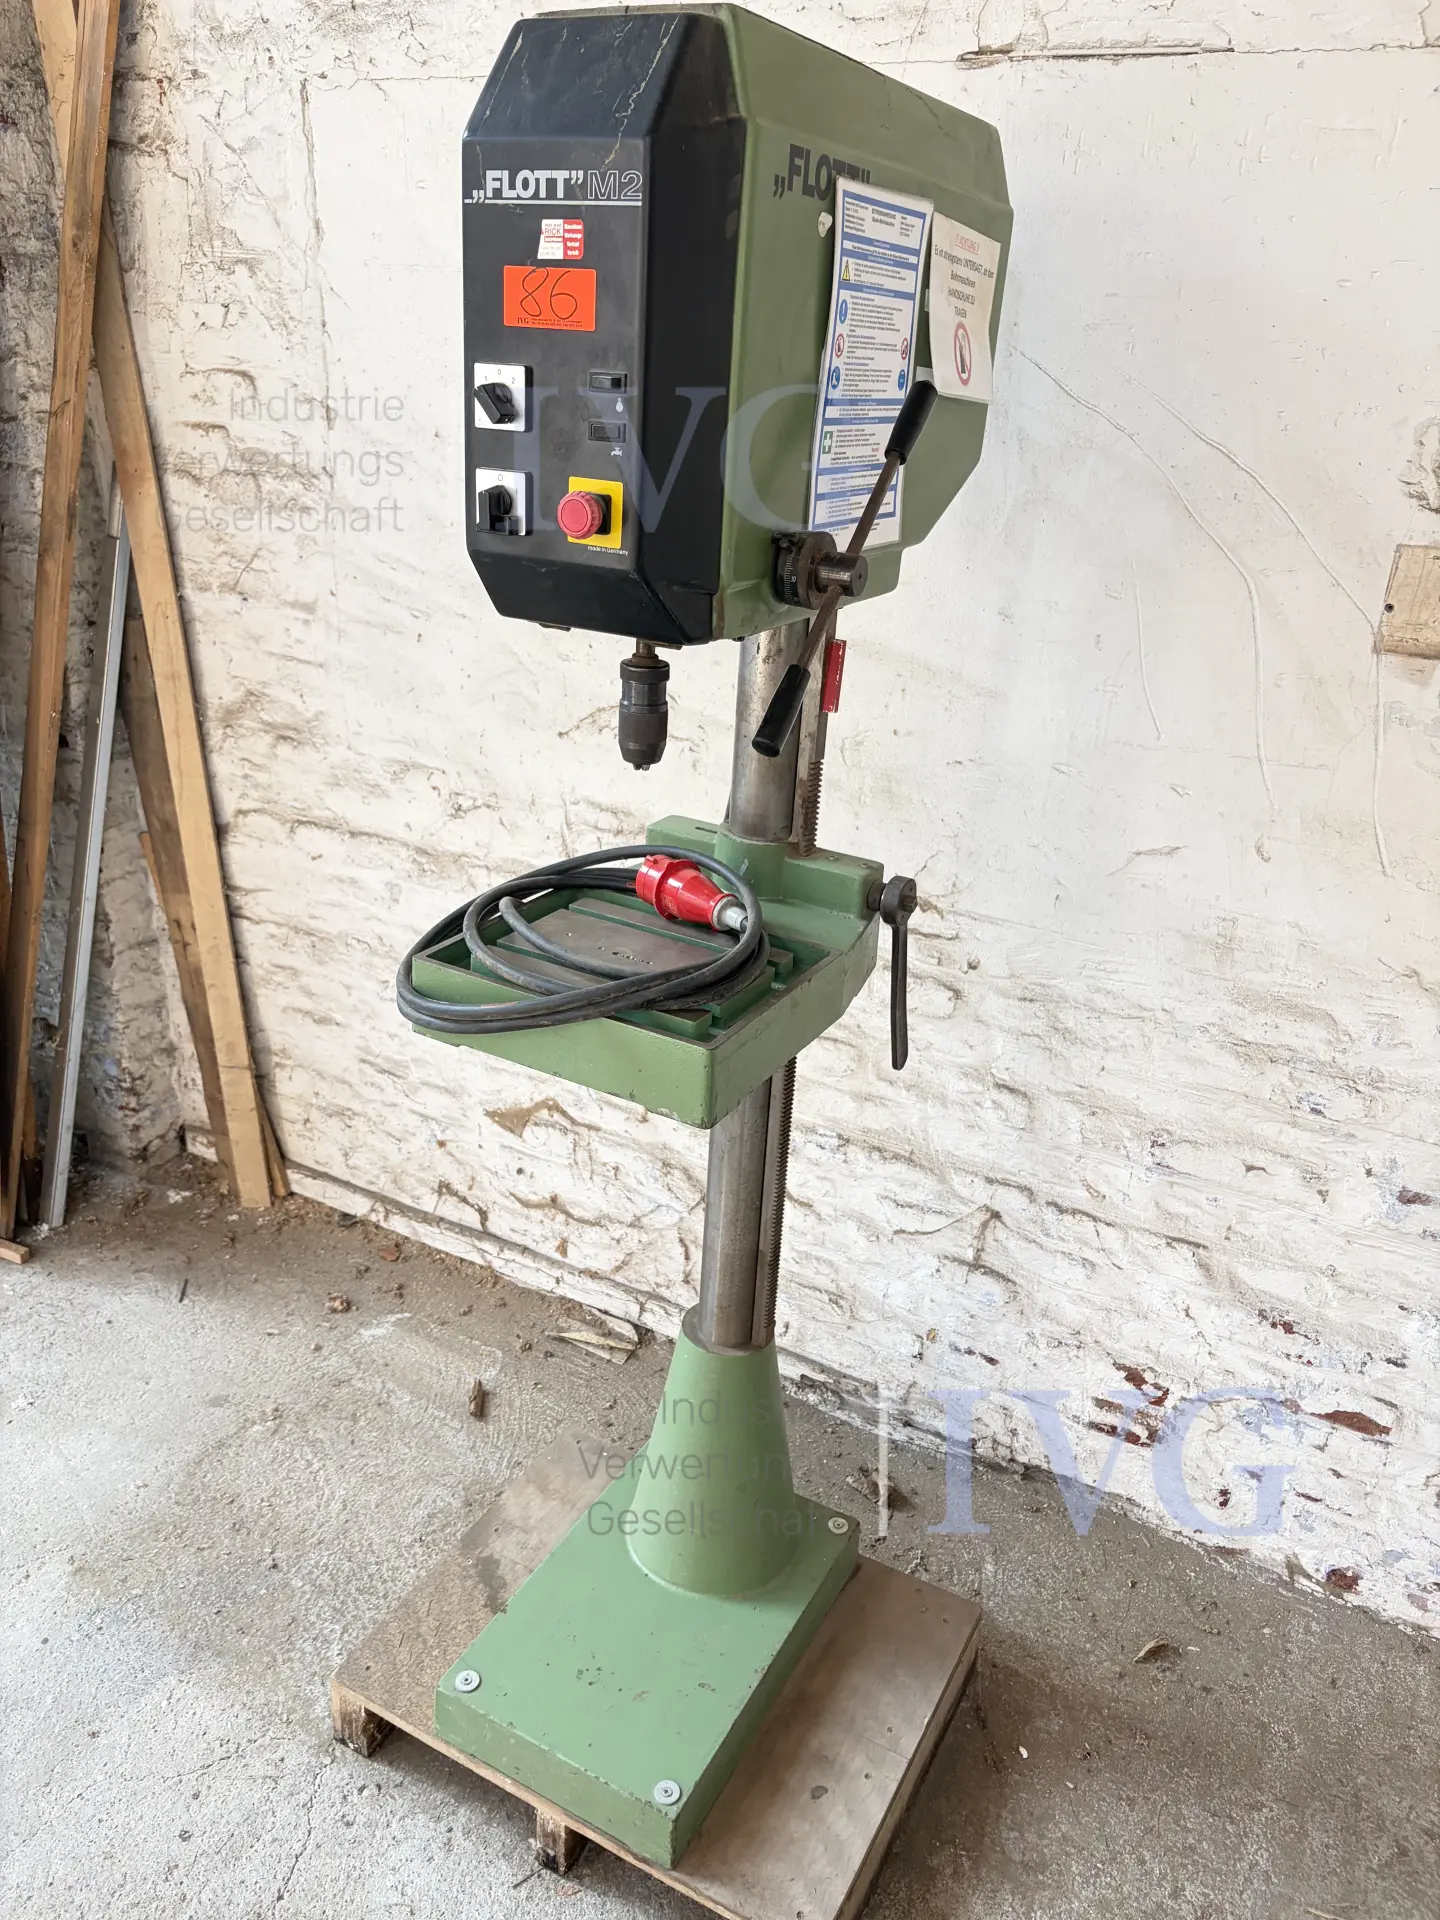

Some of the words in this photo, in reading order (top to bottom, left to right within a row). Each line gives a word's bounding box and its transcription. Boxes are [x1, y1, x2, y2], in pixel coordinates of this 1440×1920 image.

[587, 170, 642, 200] M2
[950, 269, 976, 288] Bohrmaschinen
[520, 266, 578, 320] 86
[948, 287, 971, 304] HANDSCHUHE
[954, 305, 967, 319] TRAGEN
[606, 547, 628, 557] Germany
